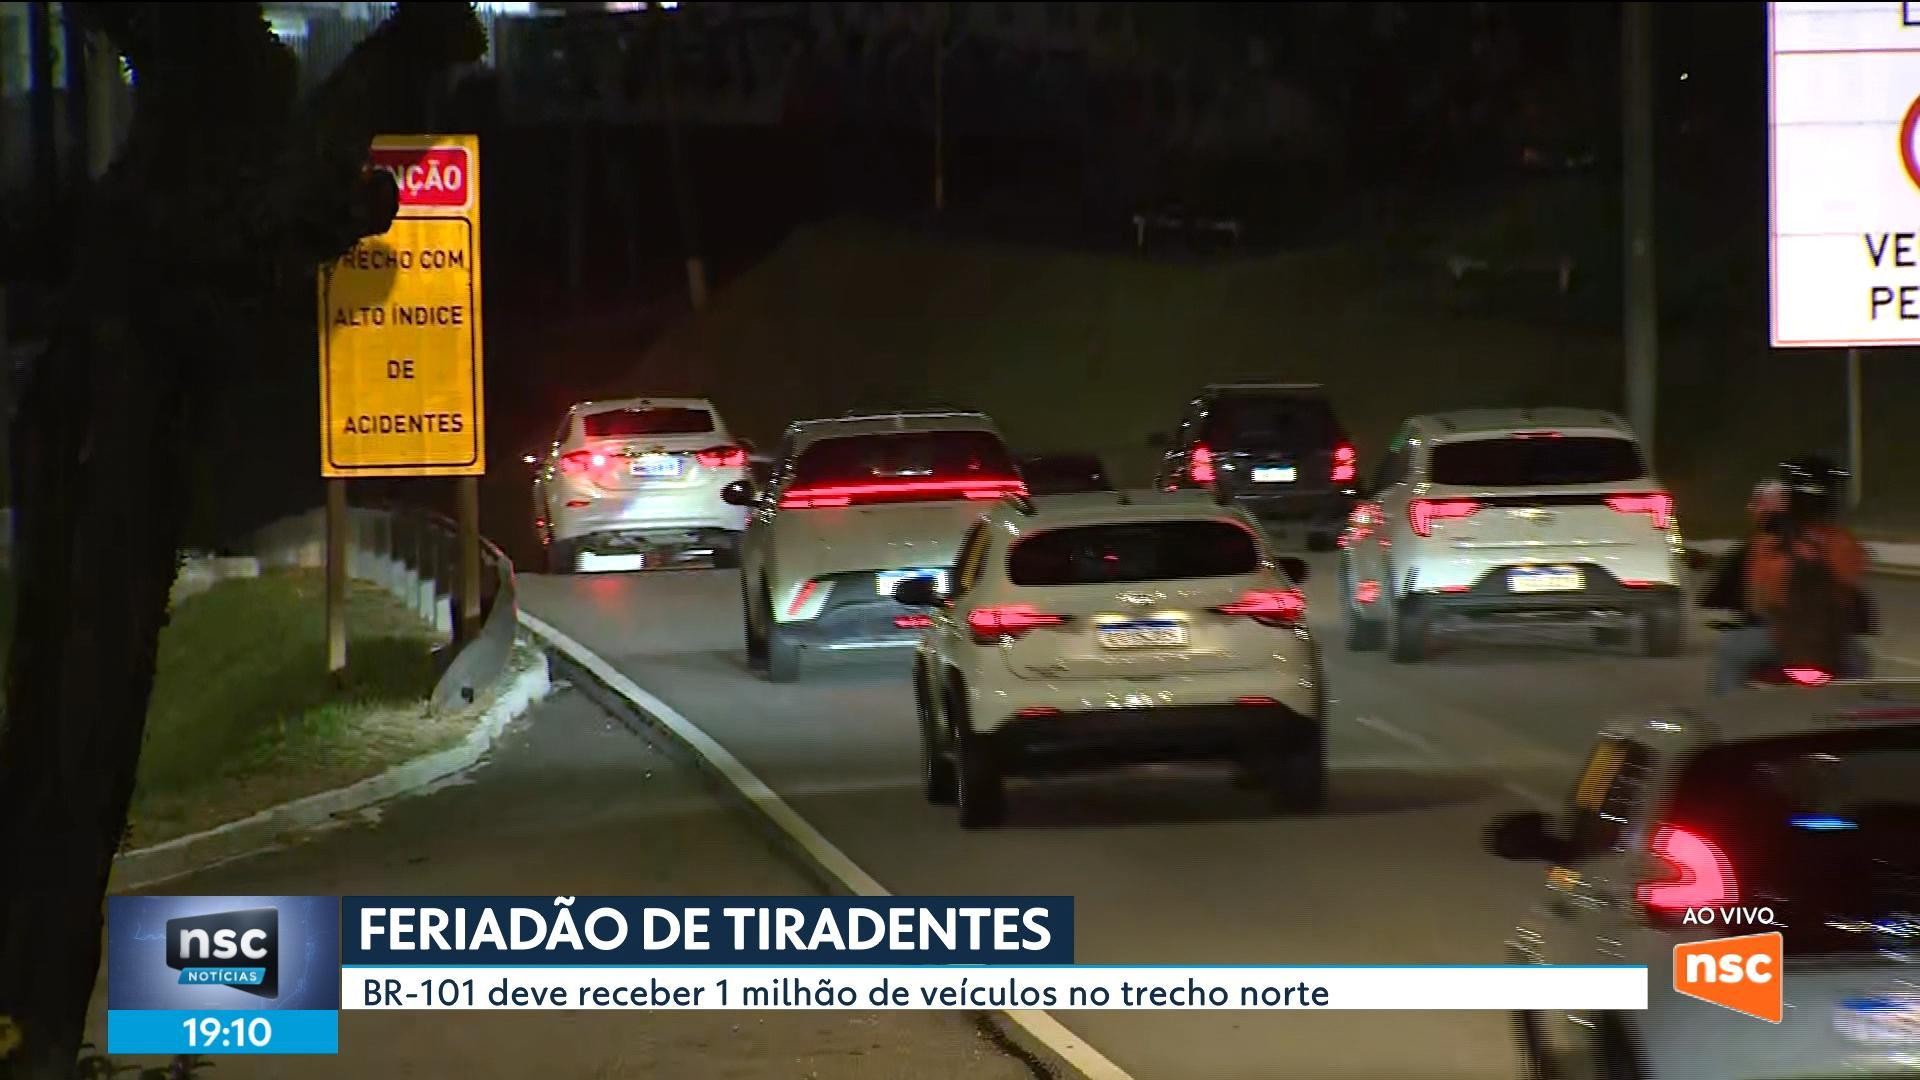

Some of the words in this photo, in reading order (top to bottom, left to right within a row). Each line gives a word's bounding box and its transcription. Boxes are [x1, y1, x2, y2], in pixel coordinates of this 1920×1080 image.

[374, 159, 462, 196] NÇÃO
[341, 250, 412, 269] RECHO
[420, 250, 464, 269] COM
[334, 306, 385, 326] ALTO
[391, 302, 464, 326] ÍNDICE
[387, 359, 416, 379] DE
[343, 413, 464, 434] ACIDENTES
